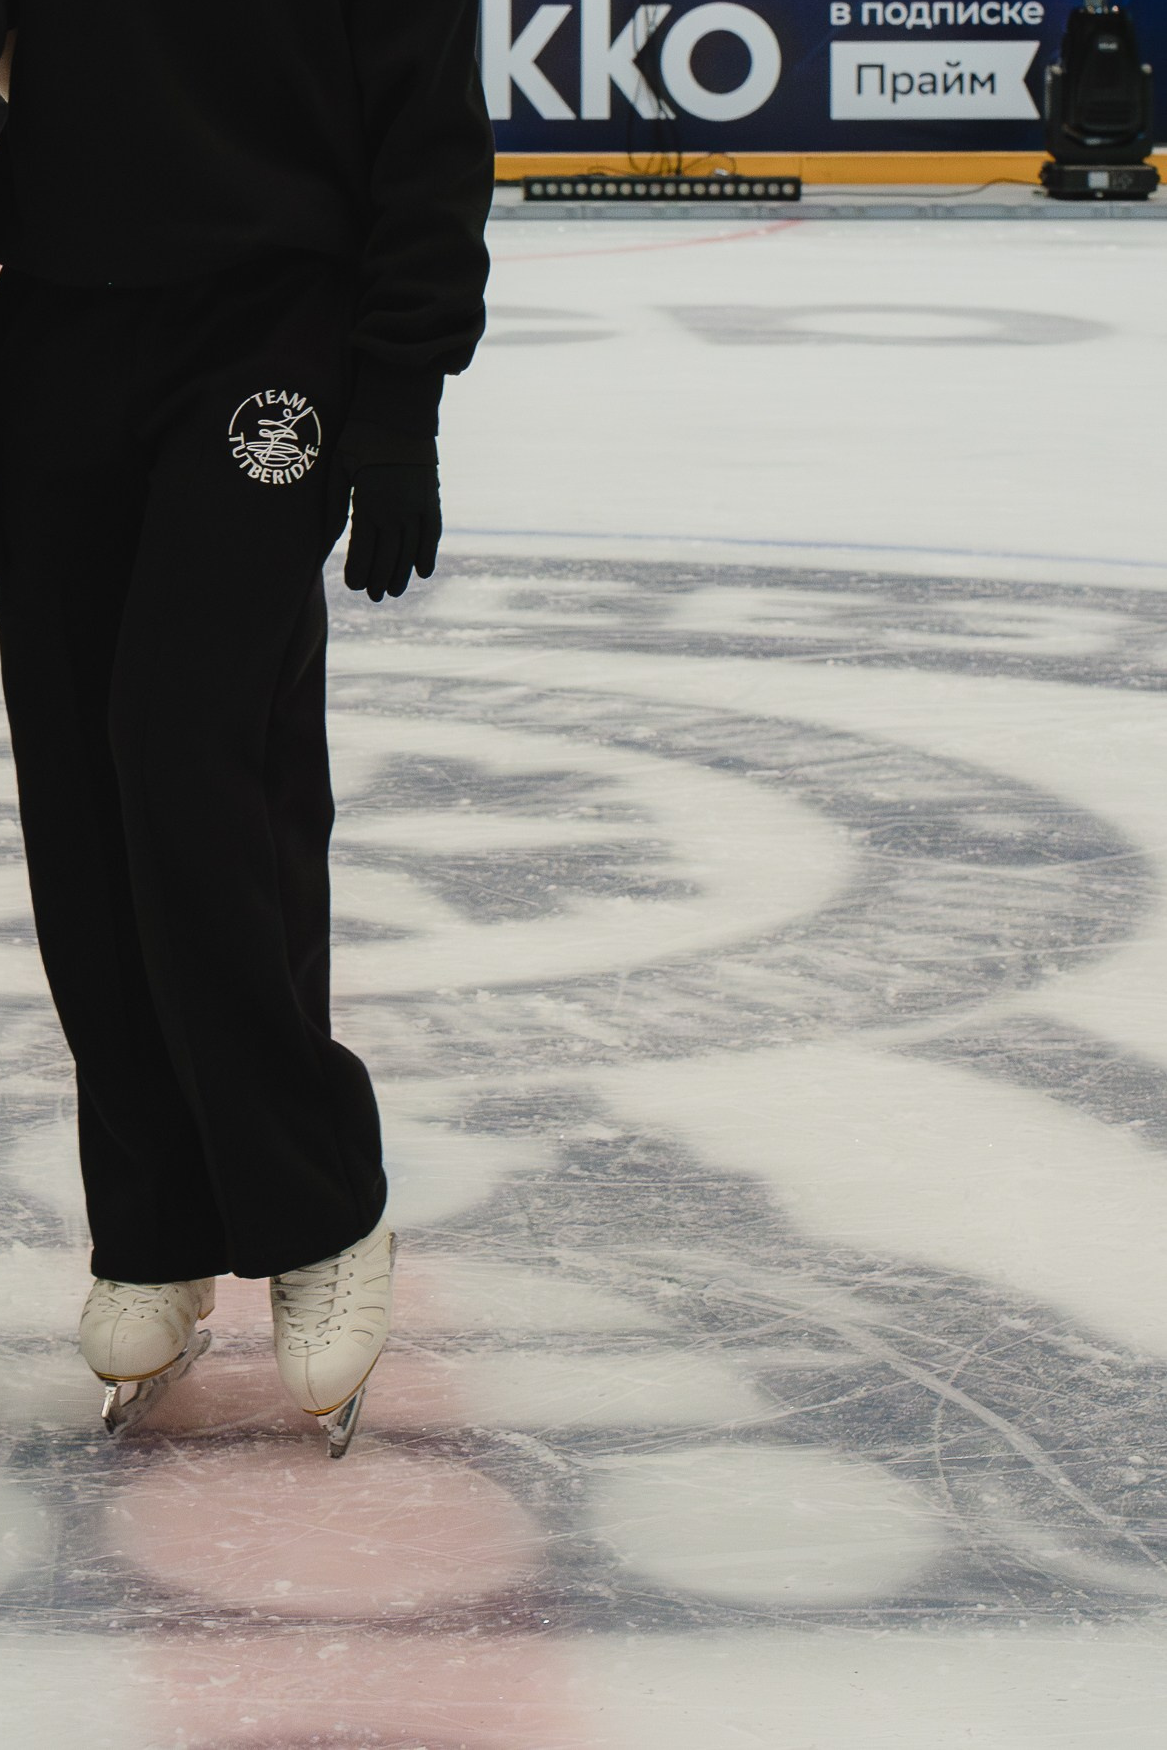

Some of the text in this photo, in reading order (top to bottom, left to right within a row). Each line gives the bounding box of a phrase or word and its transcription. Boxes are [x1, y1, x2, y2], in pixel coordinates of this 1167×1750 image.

[830, 1, 1045, 30] в подписке
[856, 61, 996, 104] Прайм
[254, 389, 307, 411] TEAM
[229, 431, 320, 485] TUTBERIDZE
